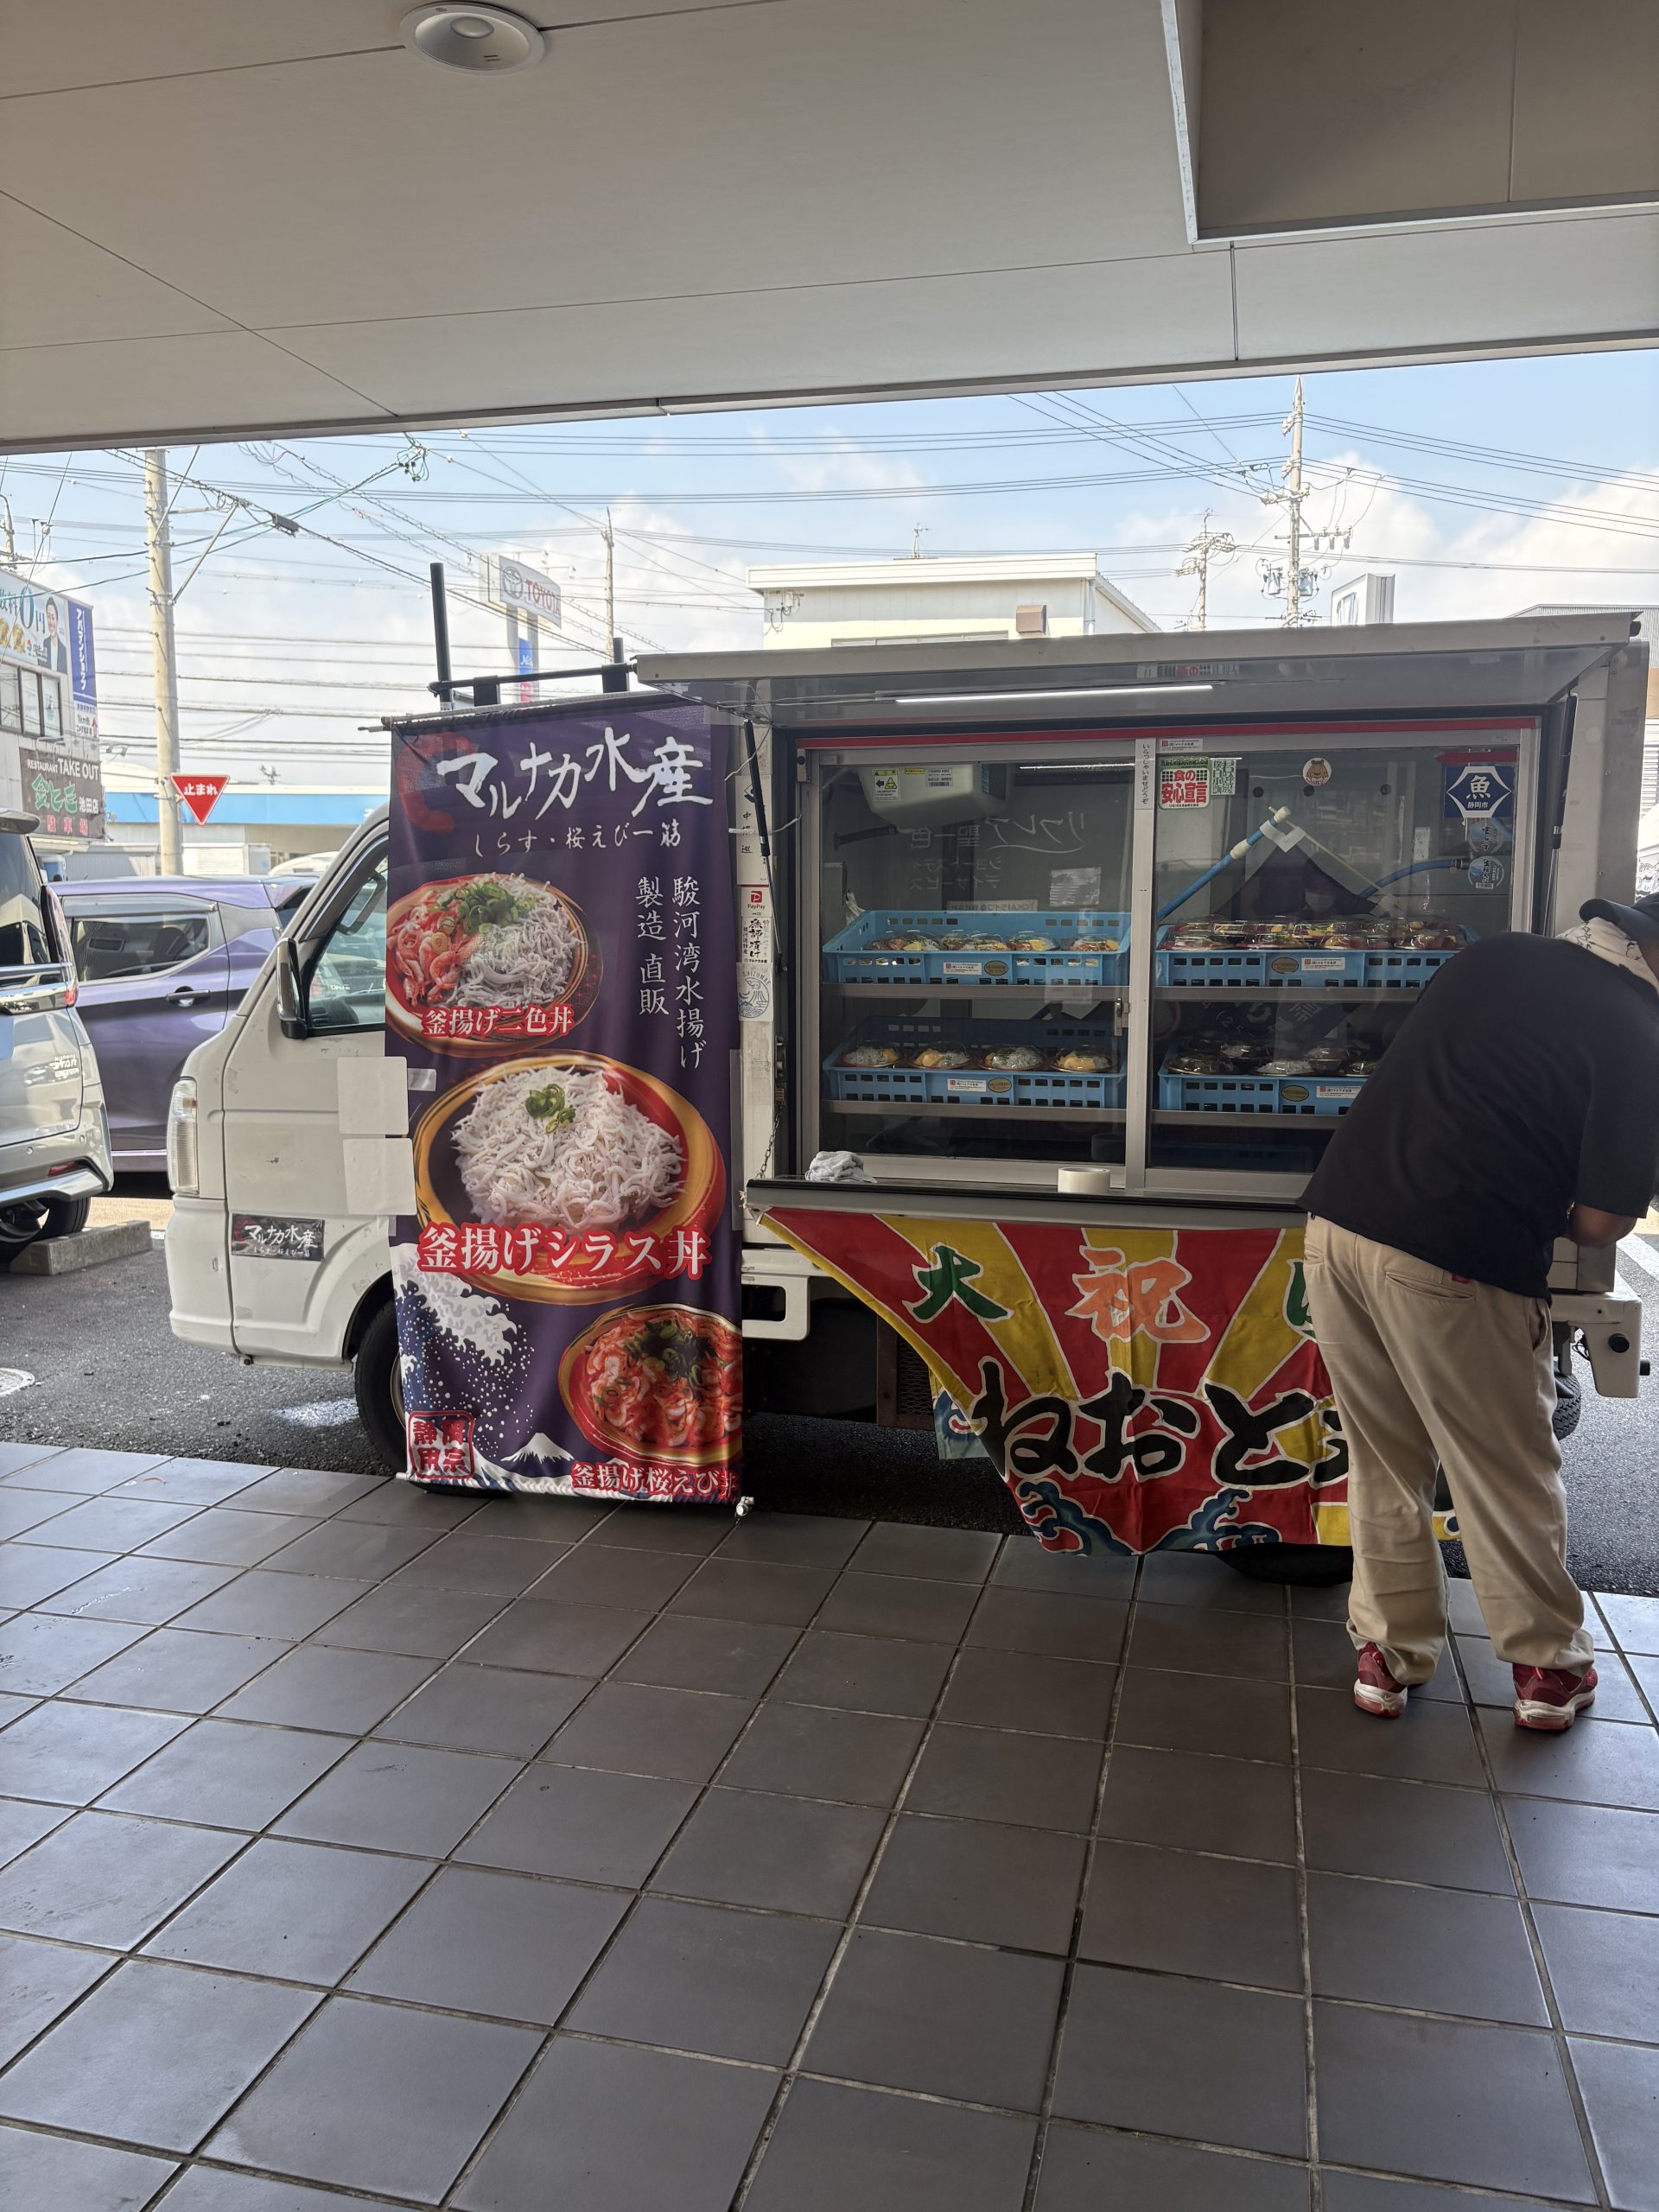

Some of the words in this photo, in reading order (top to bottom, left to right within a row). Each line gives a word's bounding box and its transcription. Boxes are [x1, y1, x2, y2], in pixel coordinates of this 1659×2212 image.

[525, 579, 561, 619] TOYOTA
[27, 759, 58, 774] RESTAURANT
[57, 758, 81, 778] TAKE
[81, 762, 99, 781] OUT
[436, 727, 714, 820] マルナカ水産
[1173, 770, 1196, 782] 食の
[183, 783, 218, 796] 止まれ
[1161, 782, 1208, 804] 安心宣言
[1466, 775, 1491, 800] 魚
[475, 818, 682, 858] しらす・桜えび一筋
[635, 876, 668, 942] 製造
[748, 918, 763, 958] 漁師漬け
[639, 954, 670, 1016] 直販
[671, 876, 705, 1069] 駿河湾水揚げ
[423, 1005, 573, 1036] 釜揚げ二色丼
[245, 1224, 318, 1249] マルナカ水産
[420, 1226, 710, 1276] 釜揚げシラス丼
[412, 1420, 465, 1446] 静岡
[416, 1447, 467, 1472] 用宗
[572, 1463, 738, 1499] 釜揚げ桜えび丼
